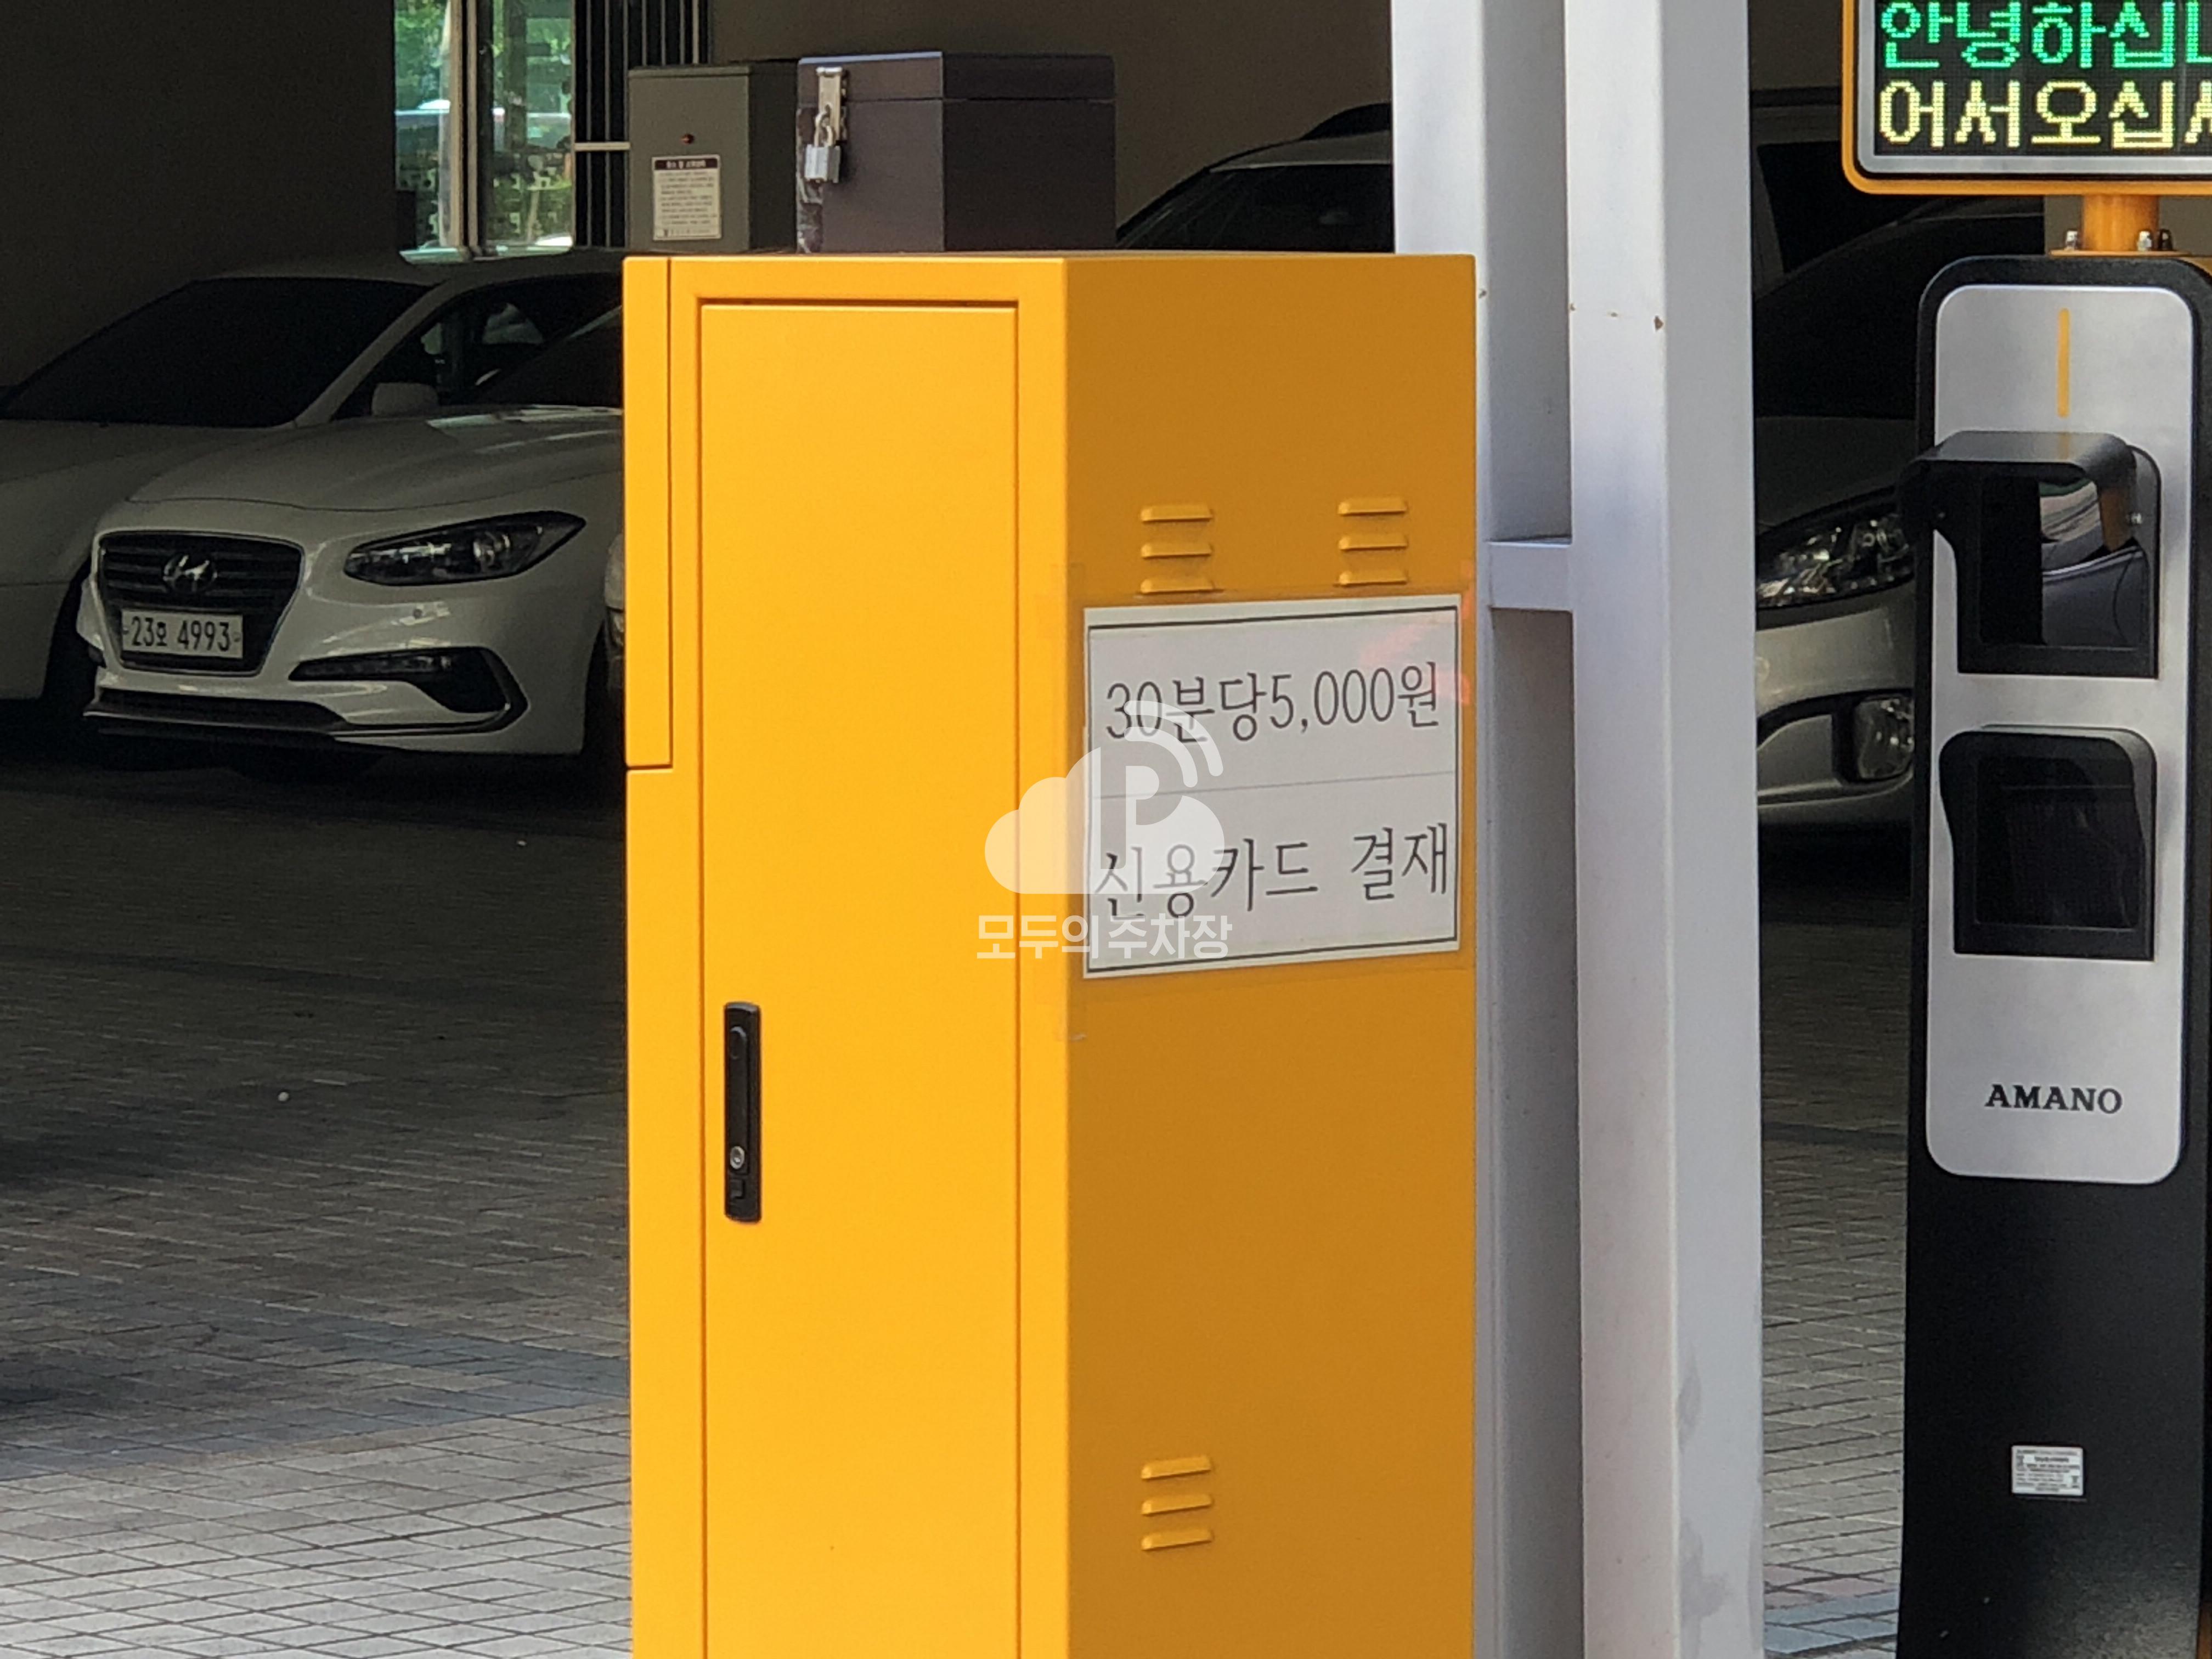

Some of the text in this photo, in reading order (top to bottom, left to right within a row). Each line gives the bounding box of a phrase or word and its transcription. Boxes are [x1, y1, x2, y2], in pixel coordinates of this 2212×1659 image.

[177, 621, 230, 651] 4993
[1096, 822, 1448, 921] 신용카드 결재
[1984, 1084, 2123, 1114] AMANO
